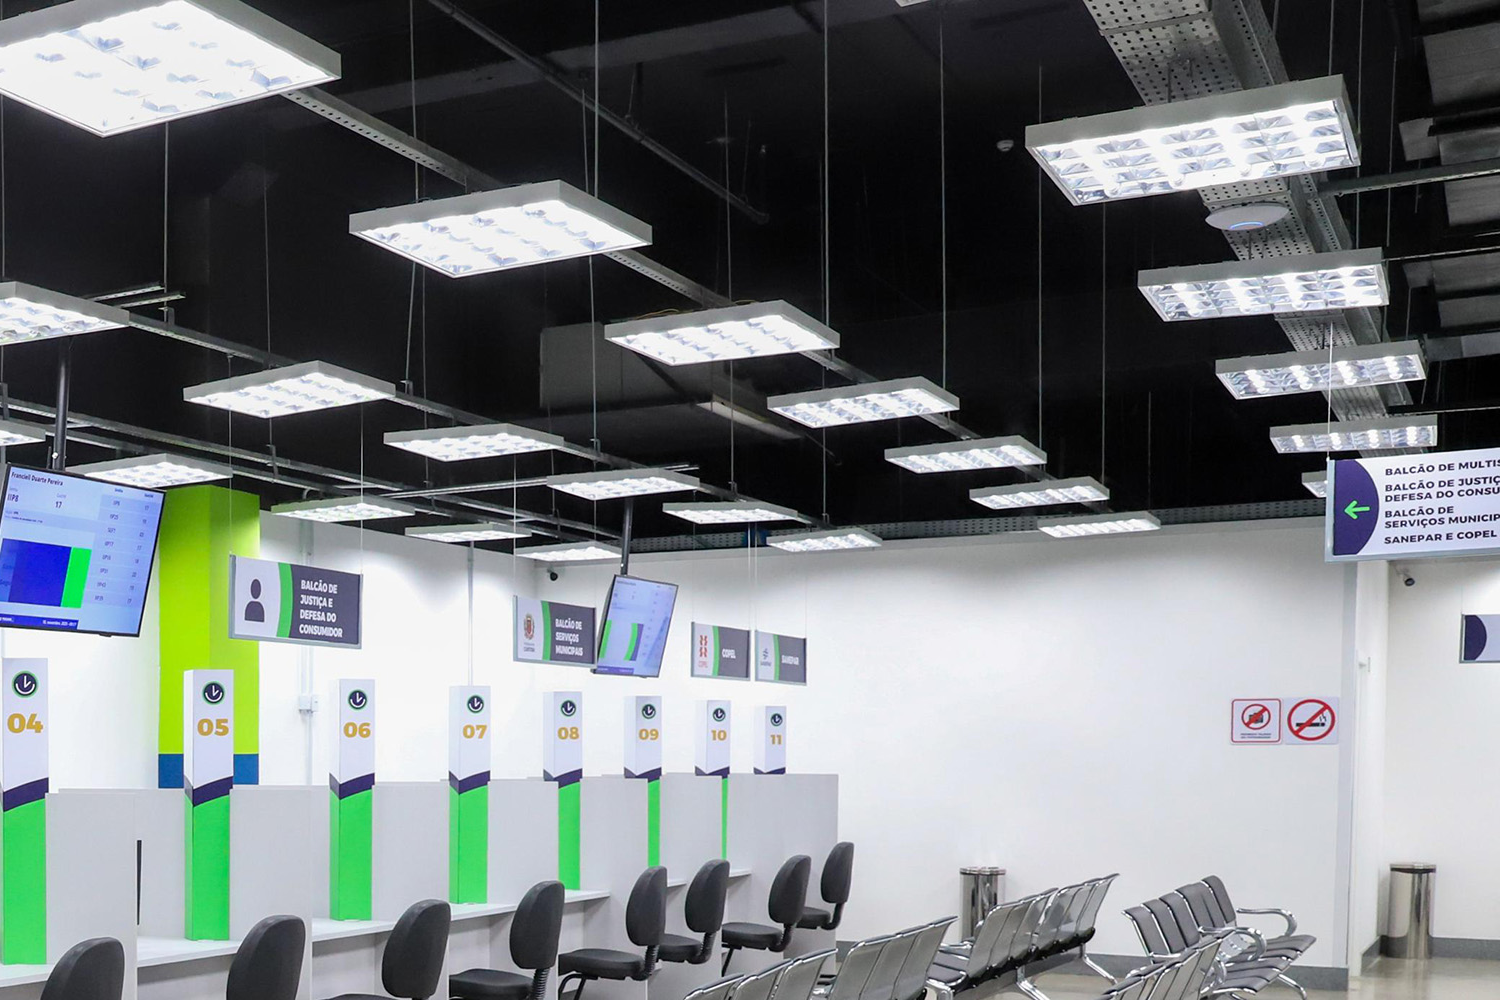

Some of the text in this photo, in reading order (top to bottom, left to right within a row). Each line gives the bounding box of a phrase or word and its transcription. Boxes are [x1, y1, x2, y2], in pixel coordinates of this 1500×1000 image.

[1385, 464, 1435, 476] BALCÃO
[1438, 463, 1455, 472] DE
[1385, 480, 1435, 492] BALCÃO
[1438, 479, 1454, 488] DE
[1385, 487, 1500, 502] DEFESA DO CONSU
[55, 501, 63, 509] 17
[1384, 506, 1454, 518] BALCÃO DE
[1384, 514, 1500, 529] SERVIÇOS MUNICIP
[1384, 533, 1442, 544] SANEPAR
[1457, 530, 1497, 539] COPEL
[301, 579, 338, 594] BALCÃO DE
[300, 595, 333, 608] JUSTIÇA E
[300, 609, 337, 623] DEFESA DO
[555, 618, 583, 630] BALCÃO DE
[299, 624, 343, 638] CONSUMIDOR
[555, 632, 579, 645] SERVIÇOS
[555, 645, 584, 656] MUNICIPAIS
[722, 648, 736, 659] COPEL
[7, 713, 44, 733] 04
[197, 718, 230, 736] 05
[343, 722, 371, 739] 06
[462, 724, 487, 739] 07
[557, 726, 580, 740] 08
[638, 728, 659, 741] 09
[711, 729, 727, 741] 10
[770, 734, 782, 745] 11
